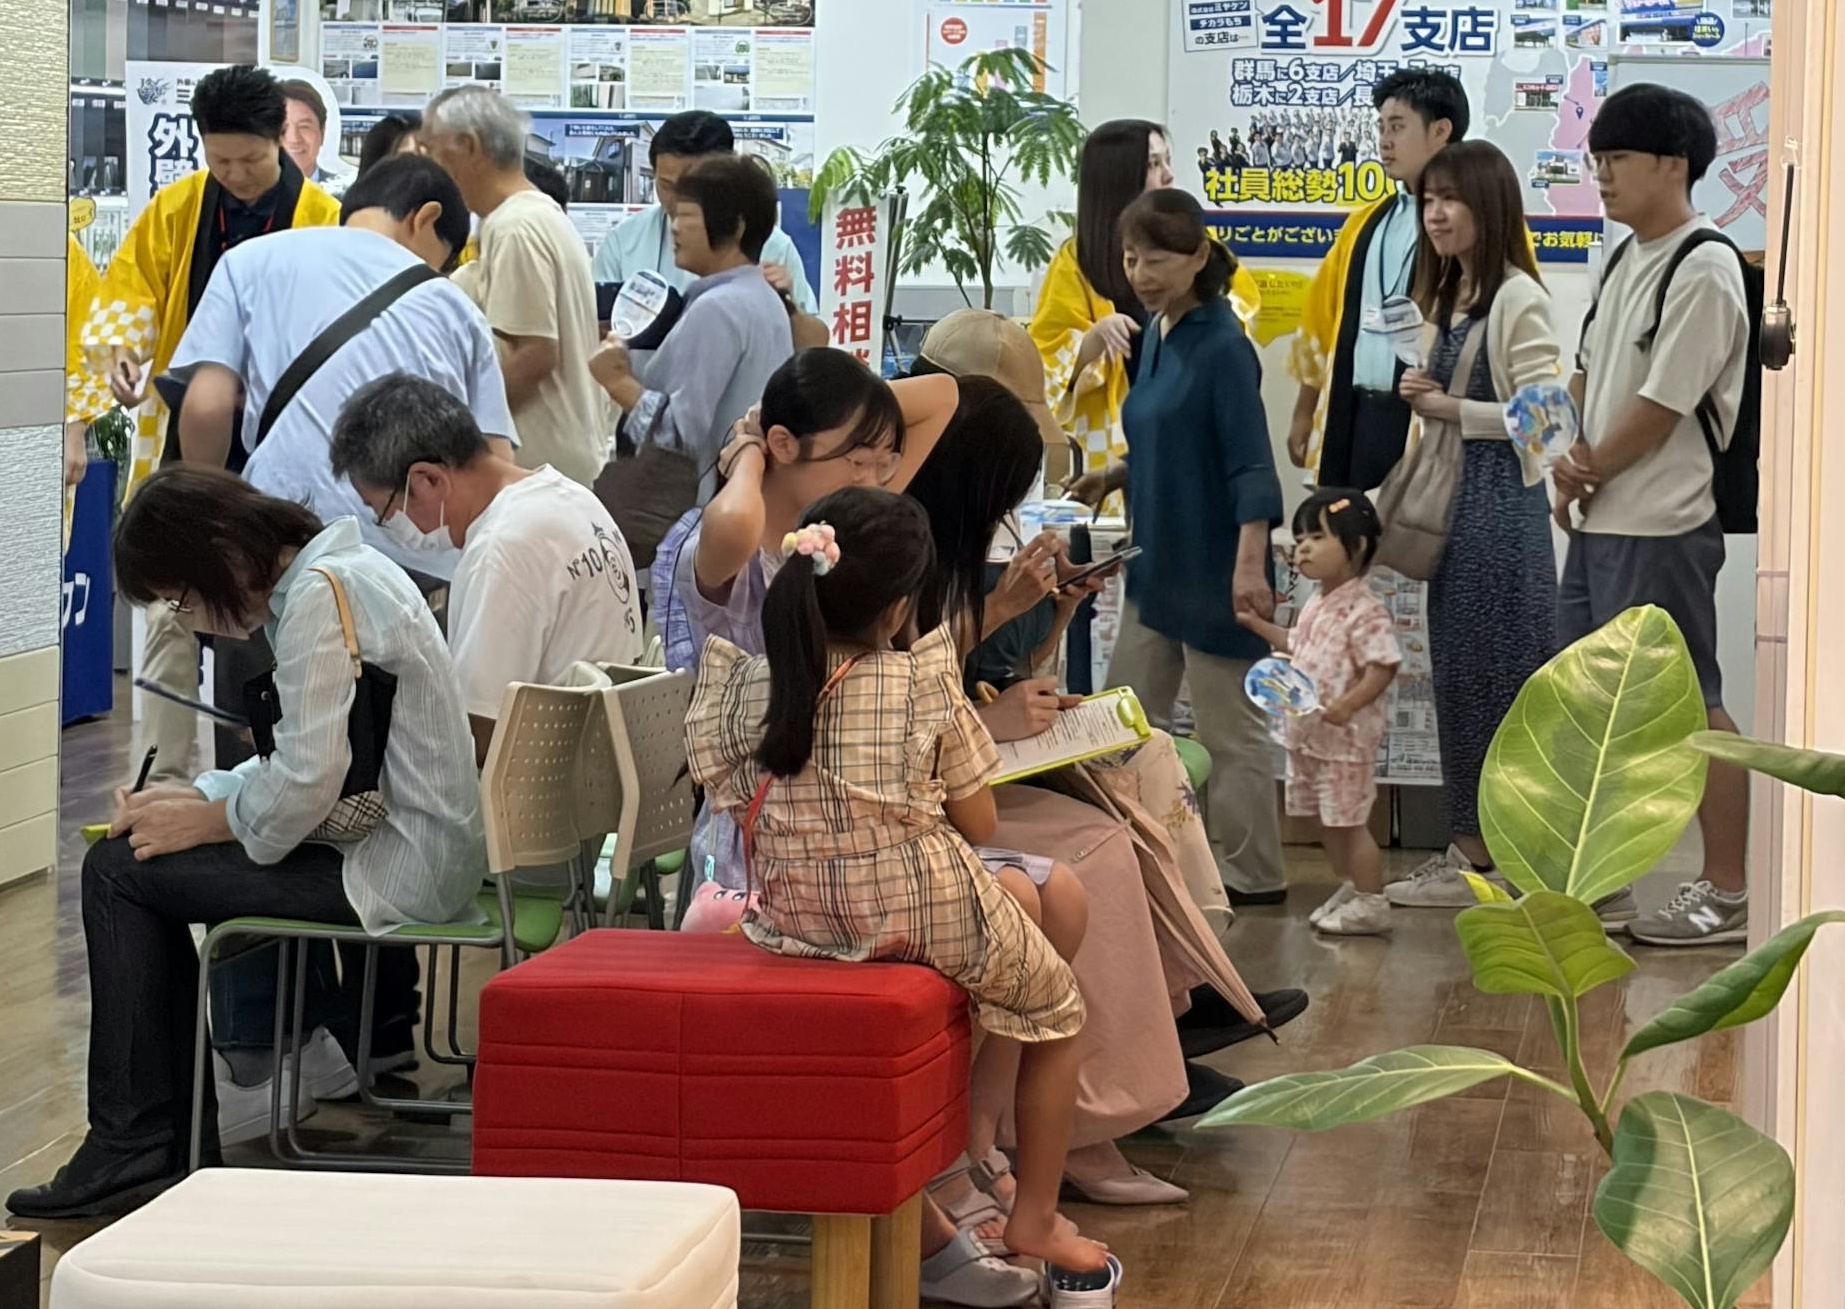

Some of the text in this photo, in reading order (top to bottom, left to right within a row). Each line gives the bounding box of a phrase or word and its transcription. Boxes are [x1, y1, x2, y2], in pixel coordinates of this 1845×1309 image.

[1198, 17, 1243, 29] チカラもち
[1688, 906, 1722, 933] N
